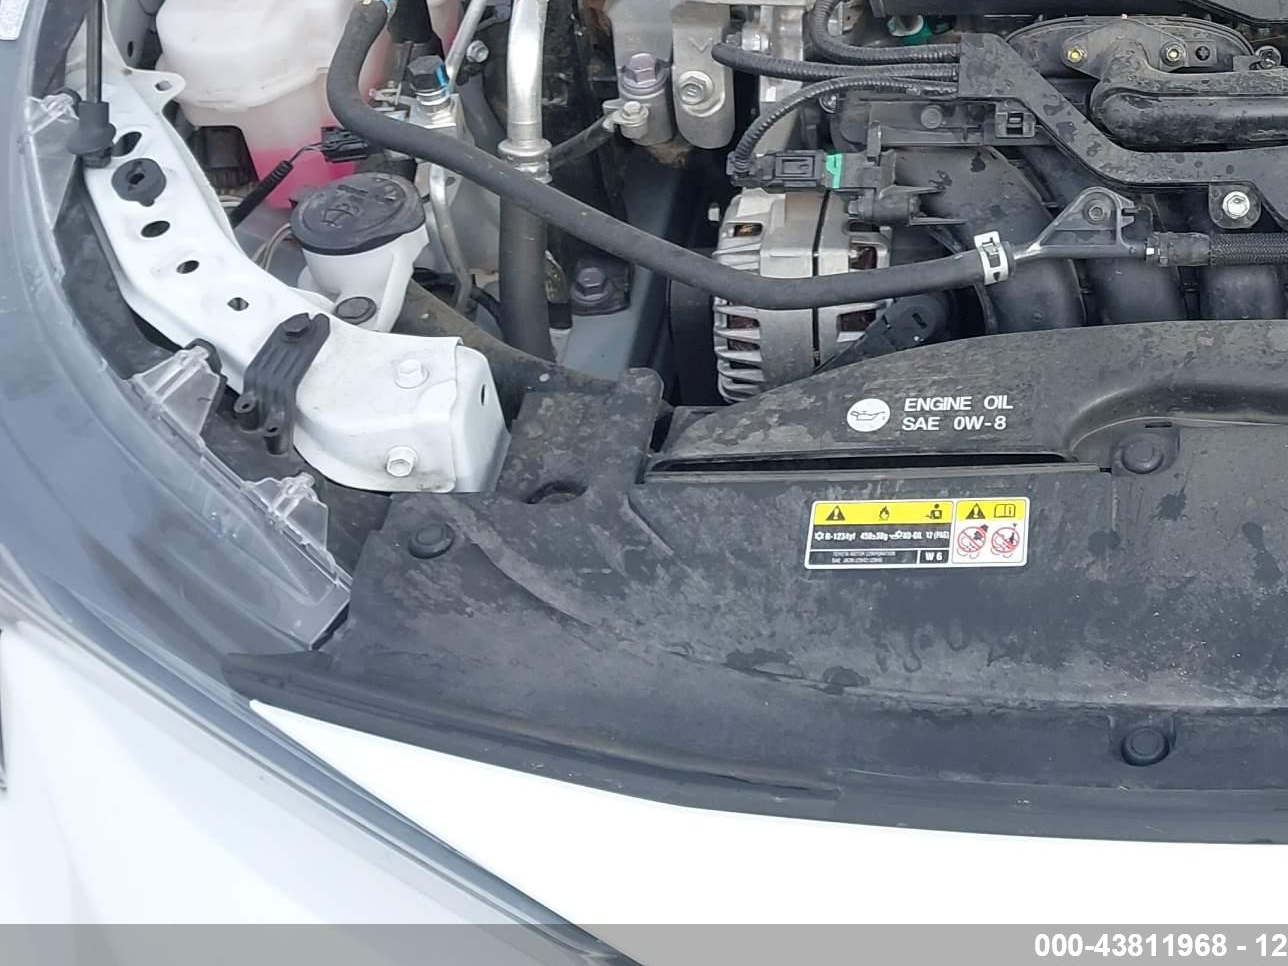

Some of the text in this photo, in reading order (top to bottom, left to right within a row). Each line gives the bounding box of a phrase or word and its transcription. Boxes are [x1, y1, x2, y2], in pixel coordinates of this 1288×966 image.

[904, 395, 1013, 412] ENGINE OIL
[902, 415, 1007, 431] SAE 0W-8
[925, 552, 943, 561] W 6
